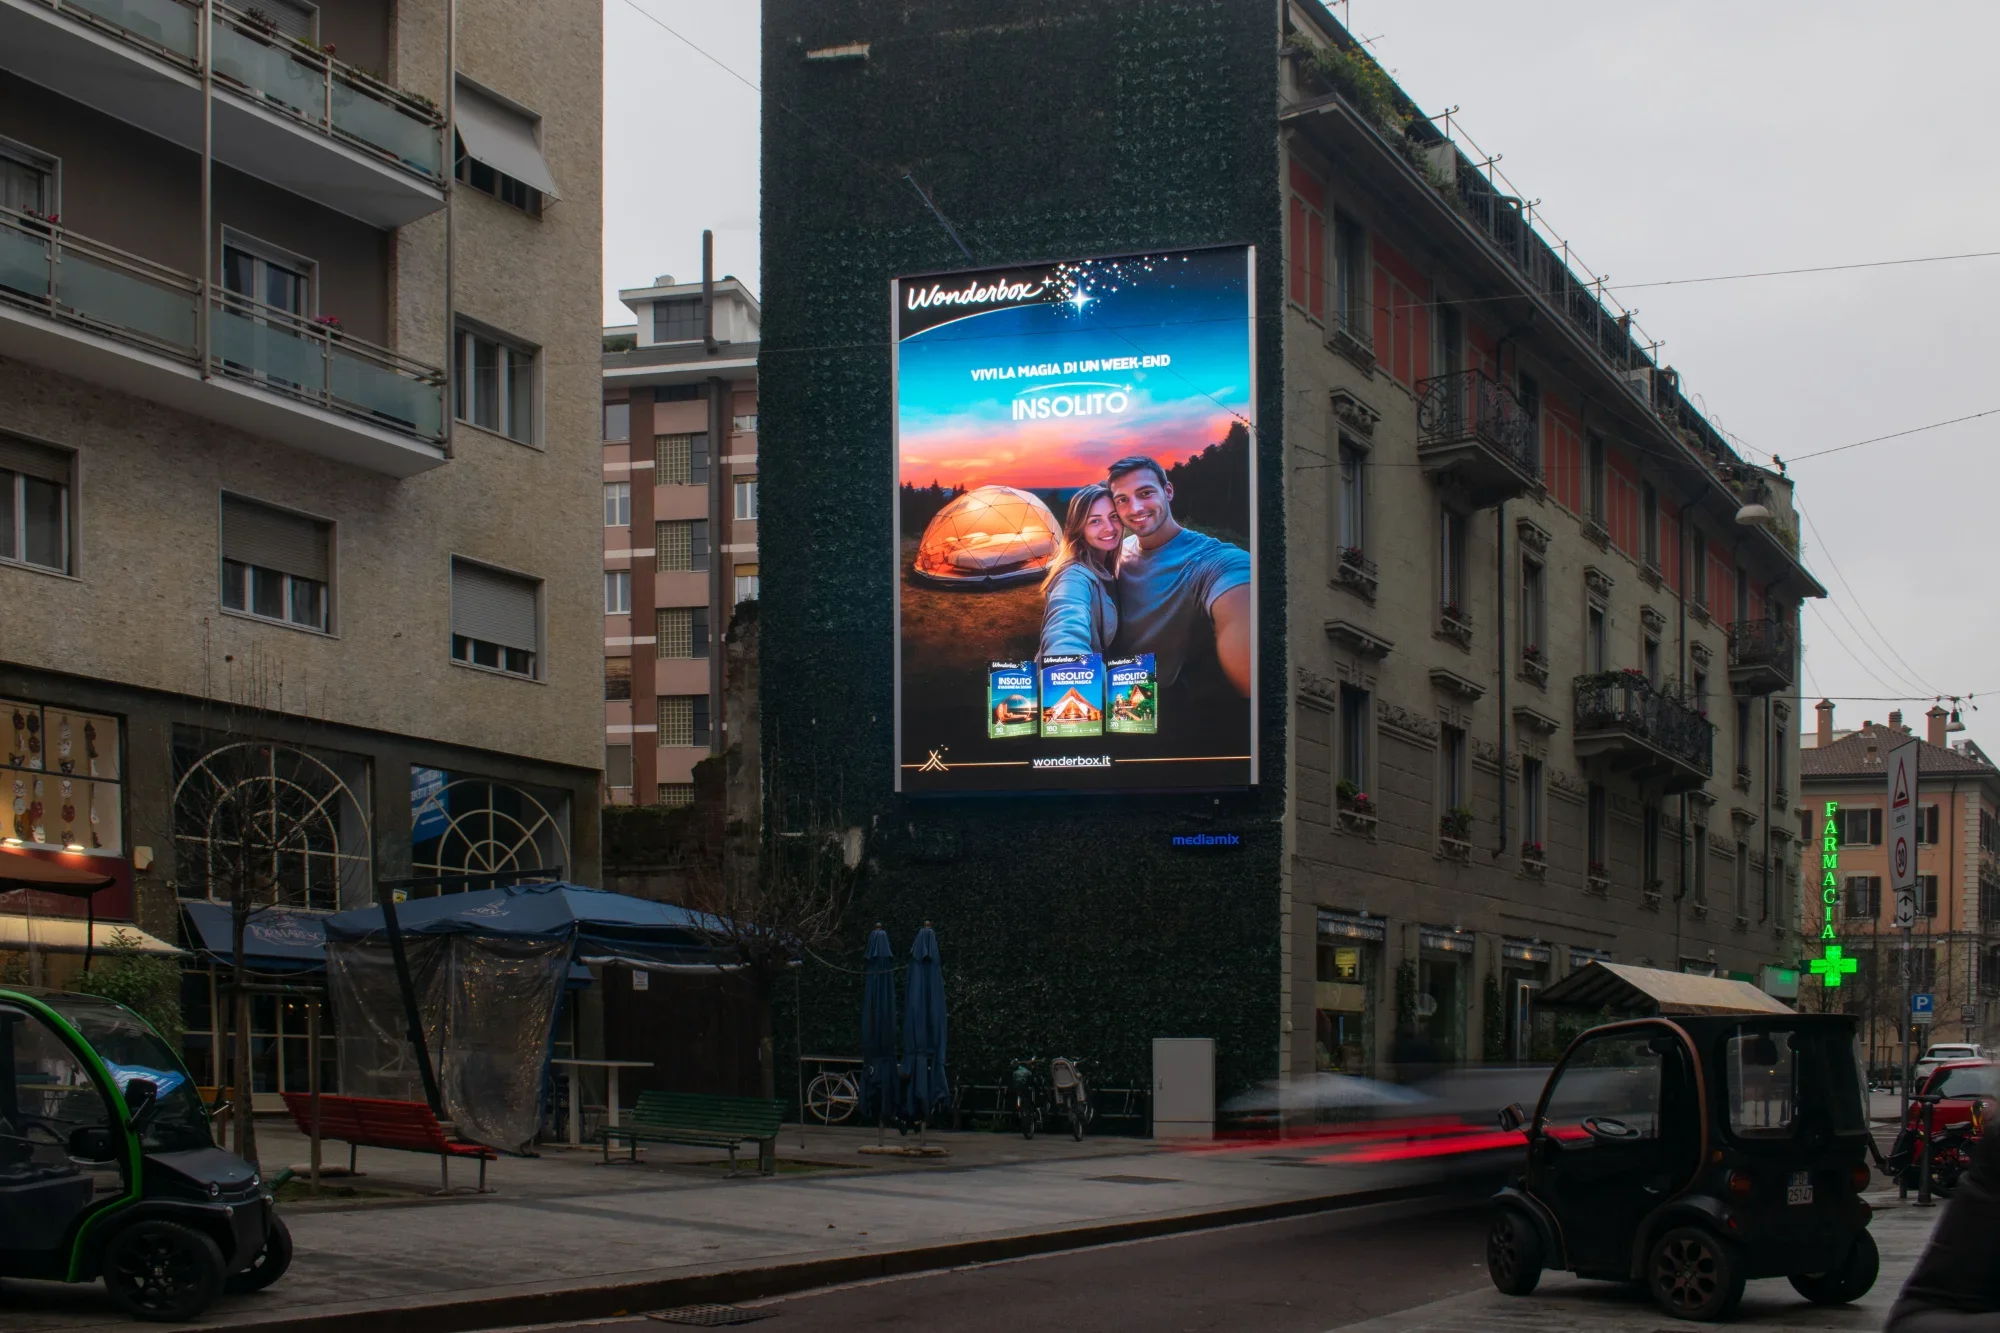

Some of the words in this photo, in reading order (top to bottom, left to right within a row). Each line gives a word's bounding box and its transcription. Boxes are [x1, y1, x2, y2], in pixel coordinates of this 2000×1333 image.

[908, 278, 1044, 310] Wonderbox
[971, 368, 998, 382] VIVI
[999, 366, 1016, 380] LA
[1018, 363, 1062, 378] MAGIA
[1064, 361, 1078, 374] DI
[1079, 358, 1100, 372] UN
[1101, 354, 1171, 371] WEEK-END
[1012, 391, 1128, 421] INSOLITO
[998, 676, 1032, 686] INSOLITO
[1051, 670, 1094, 681] INSOLITO
[1113, 671, 1148, 682] INSOLITO
[1033, 756, 1111, 766] wonderbox.it
[1172, 833, 1240, 845] mediamix
[1897, 847, 1905, 869] 30
[1821, 801, 1839, 940] FARMACIA
[1916, 996, 1929, 1010] P
